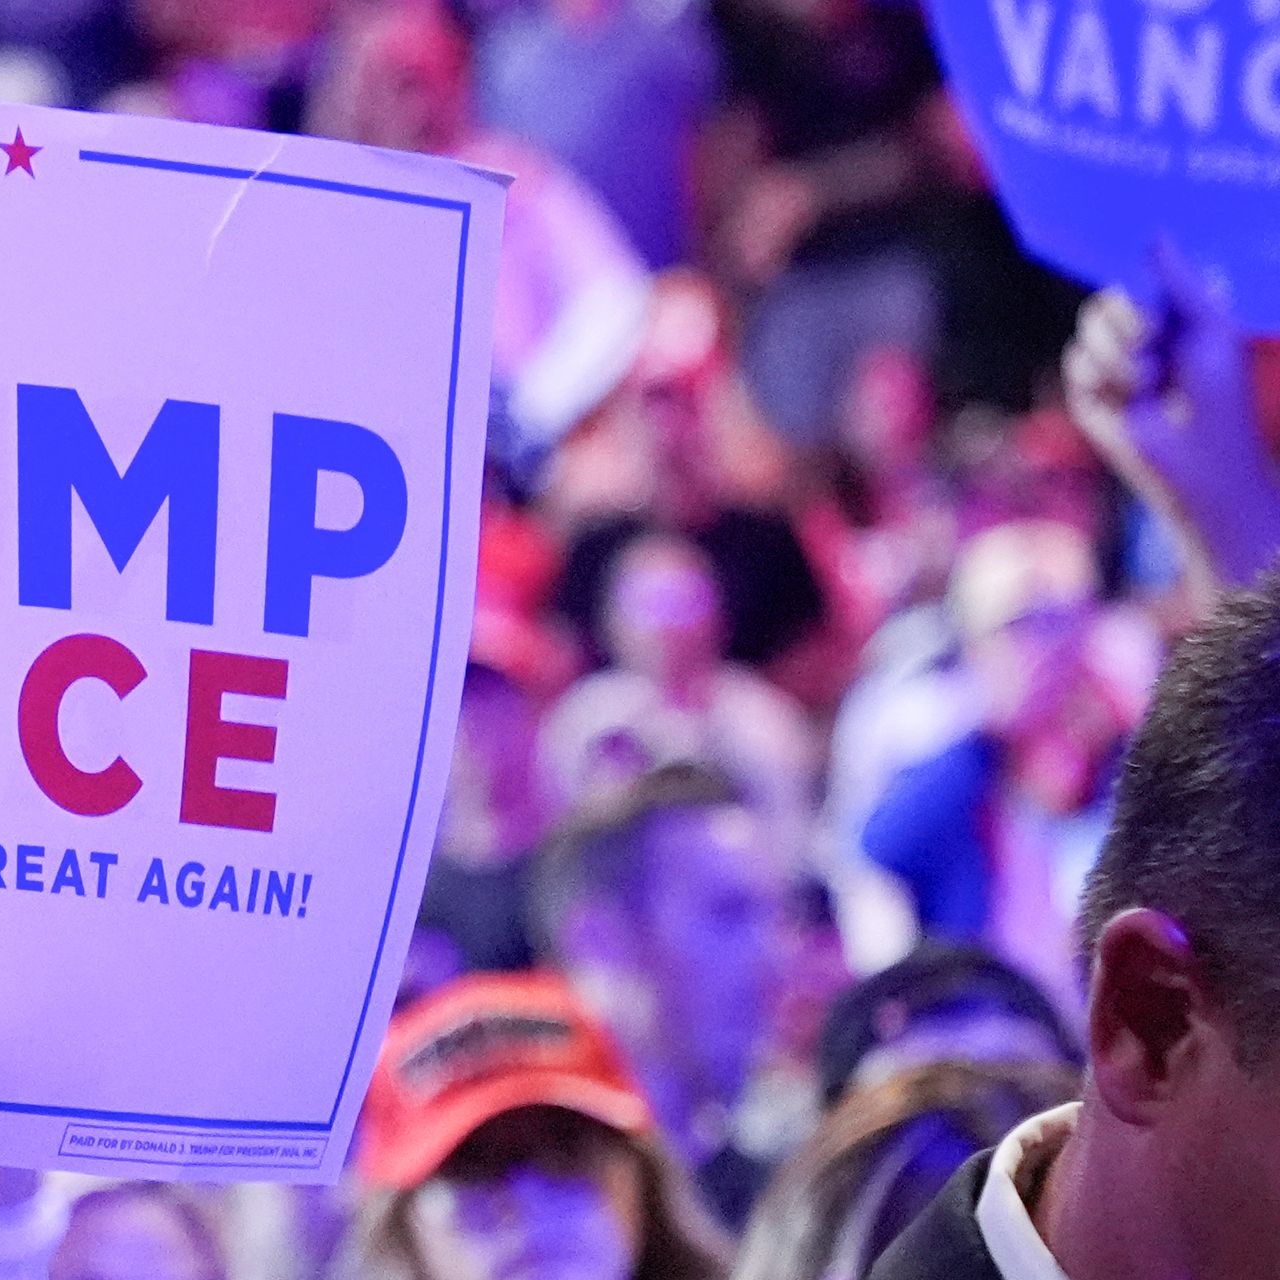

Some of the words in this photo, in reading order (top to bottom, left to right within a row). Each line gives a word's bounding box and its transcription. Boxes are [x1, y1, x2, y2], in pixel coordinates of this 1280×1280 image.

[136, 857, 315, 919] AGAIN!
[69, 1134, 95, 1148] PAID
[97, 1137, 118, 1150] FOR
[120, 1139, 135, 1151] BY
[135, 1140, 177, 1154] DONALD
